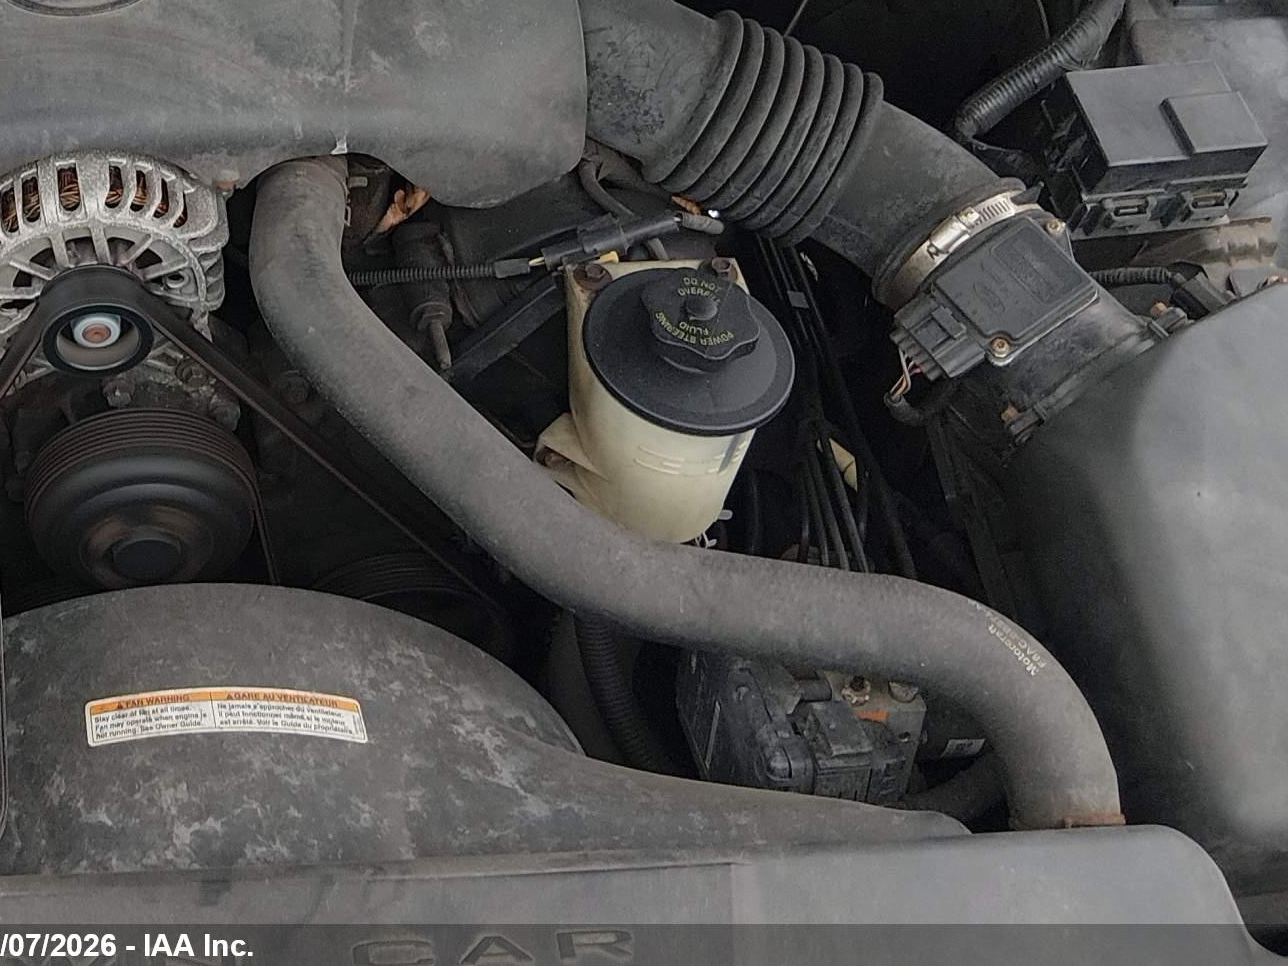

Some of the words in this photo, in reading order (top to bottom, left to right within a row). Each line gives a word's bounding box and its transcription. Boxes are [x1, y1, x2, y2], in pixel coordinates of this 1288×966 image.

[683, 277, 697, 285] DO
[701, 281, 721, 292] NOT
[656, 312, 696, 344] STEERING
[679, 322, 708, 335] FLUID
[700, 331, 734, 346] POWER
[988, 624, 1040, 676] Motorcraft
[146, 694, 190, 705] WARNING
[277, 694, 338, 707] VENTILATEUR
[94, 715, 110, 723] Stay
[111, 713, 128, 721] clear
[109, 721, 124, 730] may
[126, 717, 152, 726] operate
[175, 713, 199, 721] engine
[155, 722, 178, 730] Owner
[352, 929, 633, 966] CAR
